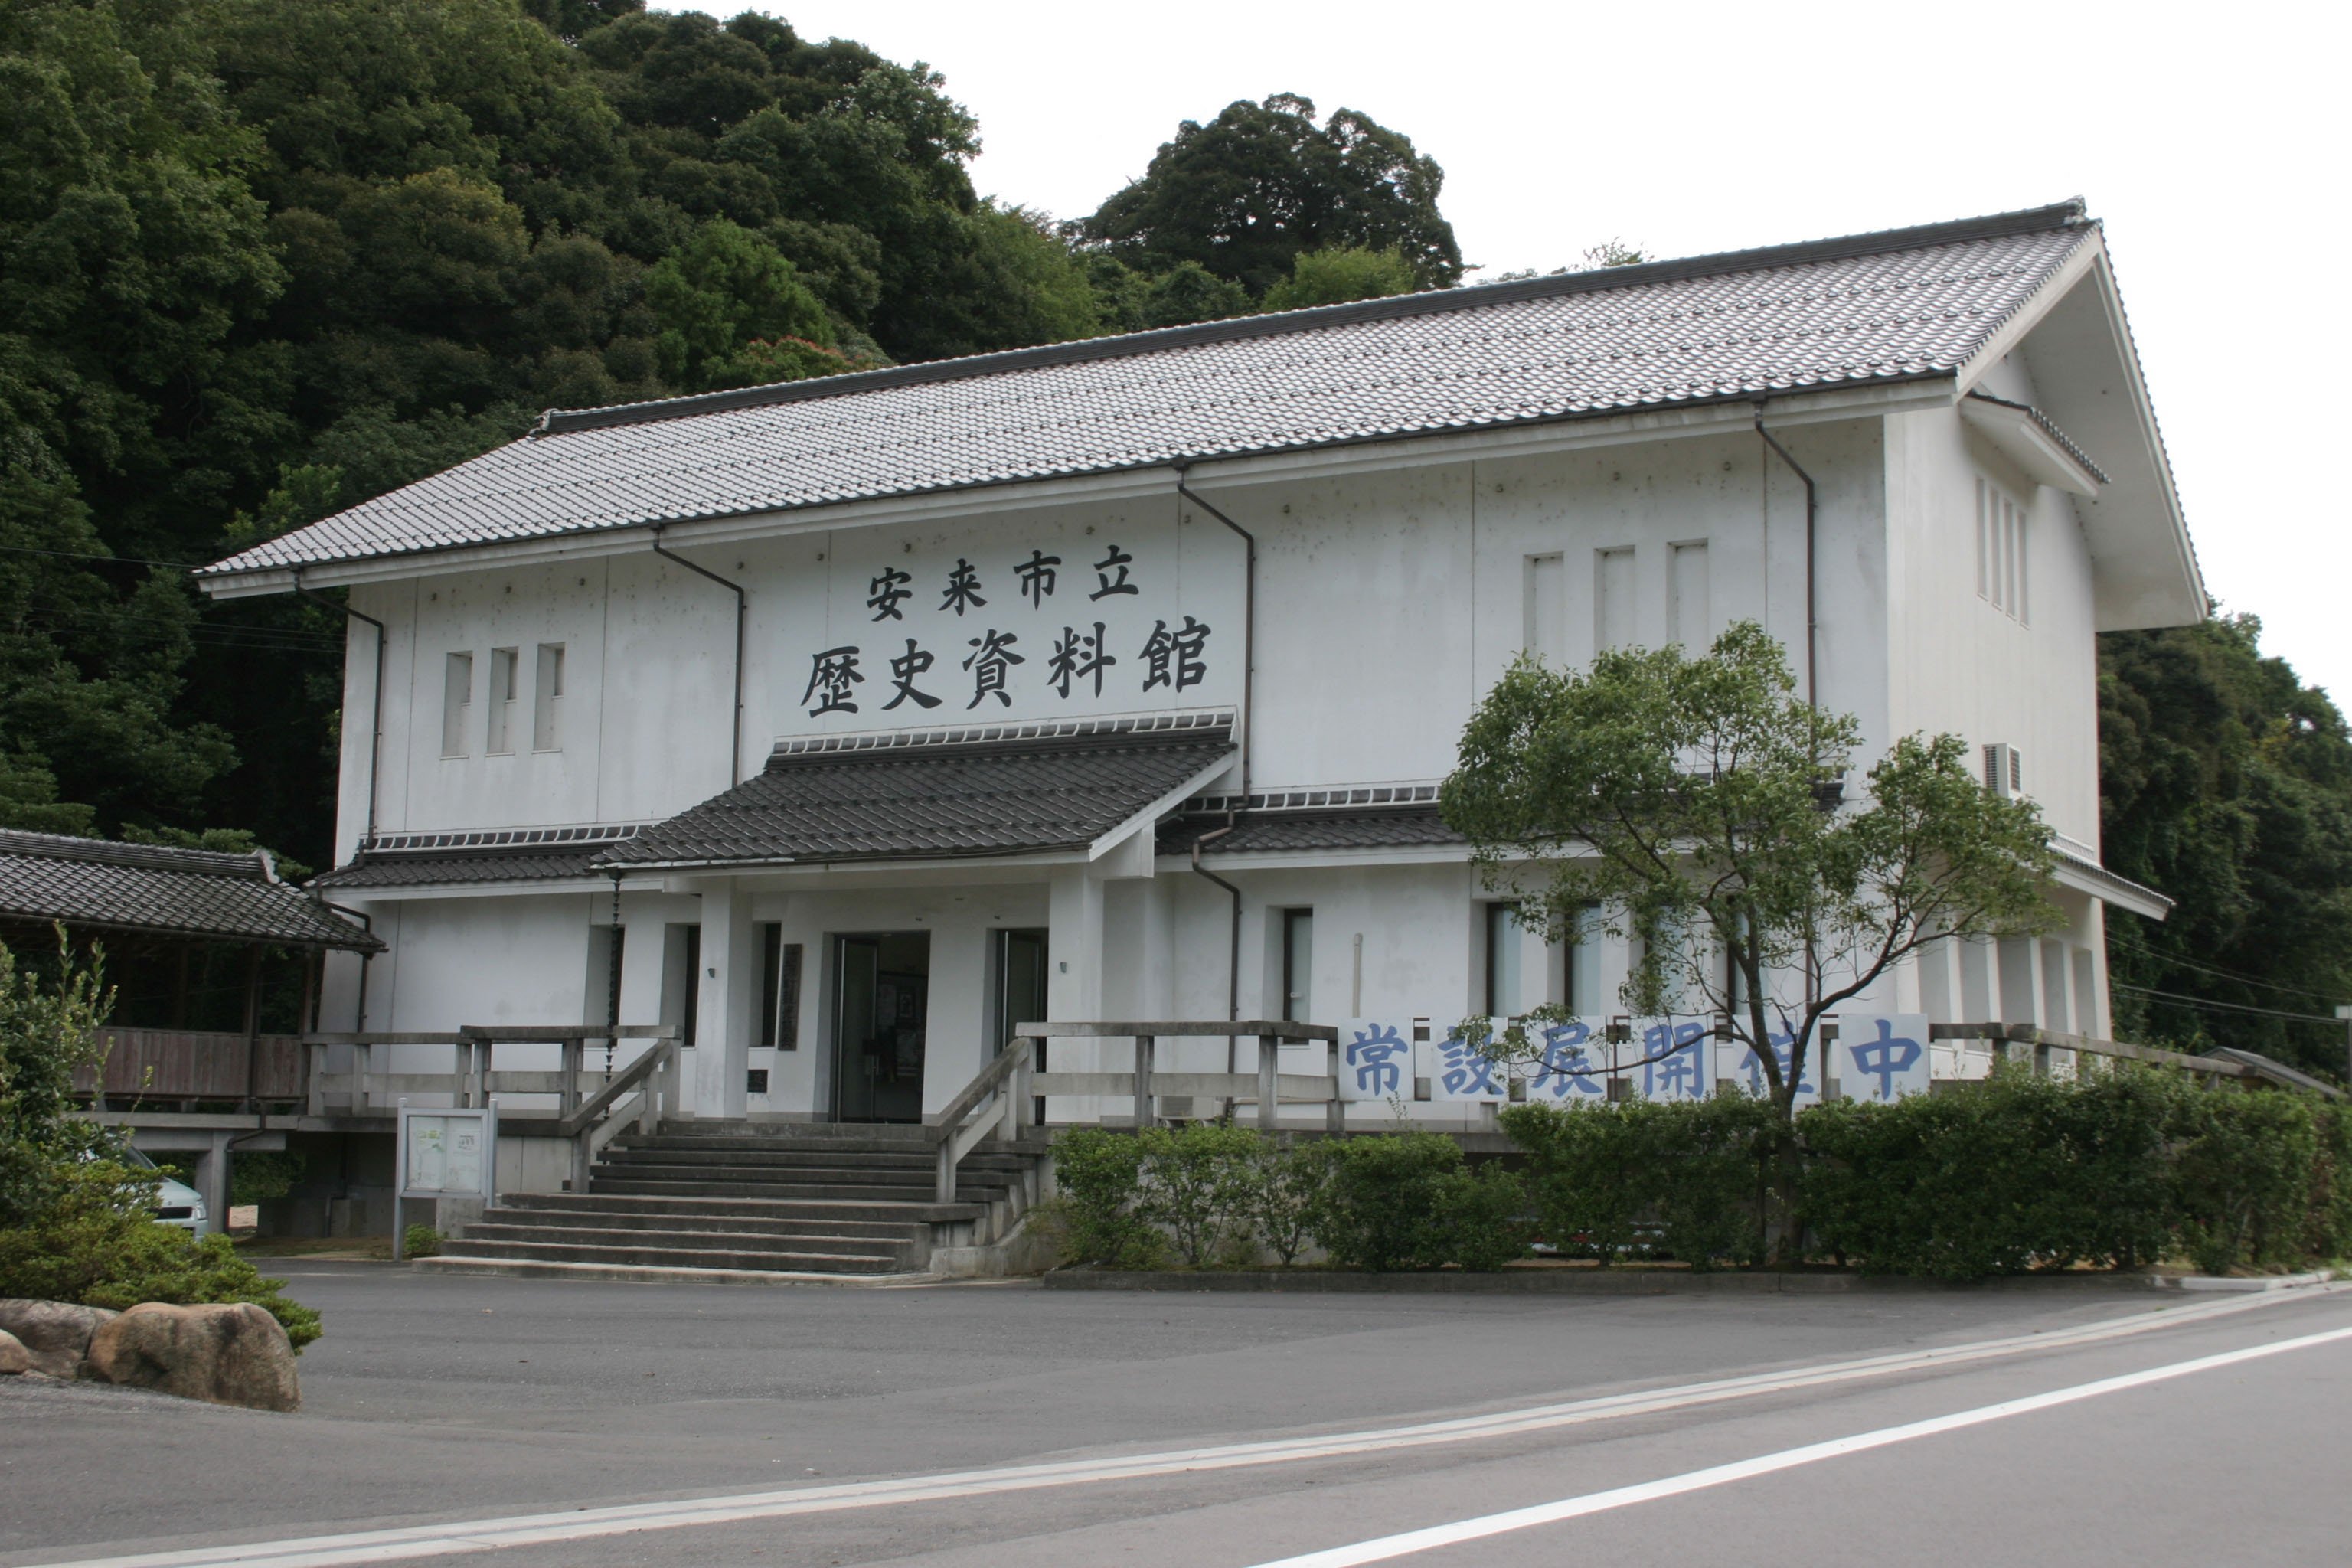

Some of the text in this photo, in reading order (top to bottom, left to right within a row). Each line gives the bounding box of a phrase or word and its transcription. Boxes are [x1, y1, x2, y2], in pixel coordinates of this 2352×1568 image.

[867, 544, 1139, 622] 安来市立
[801, 616, 1212, 719] 歴史資料館
